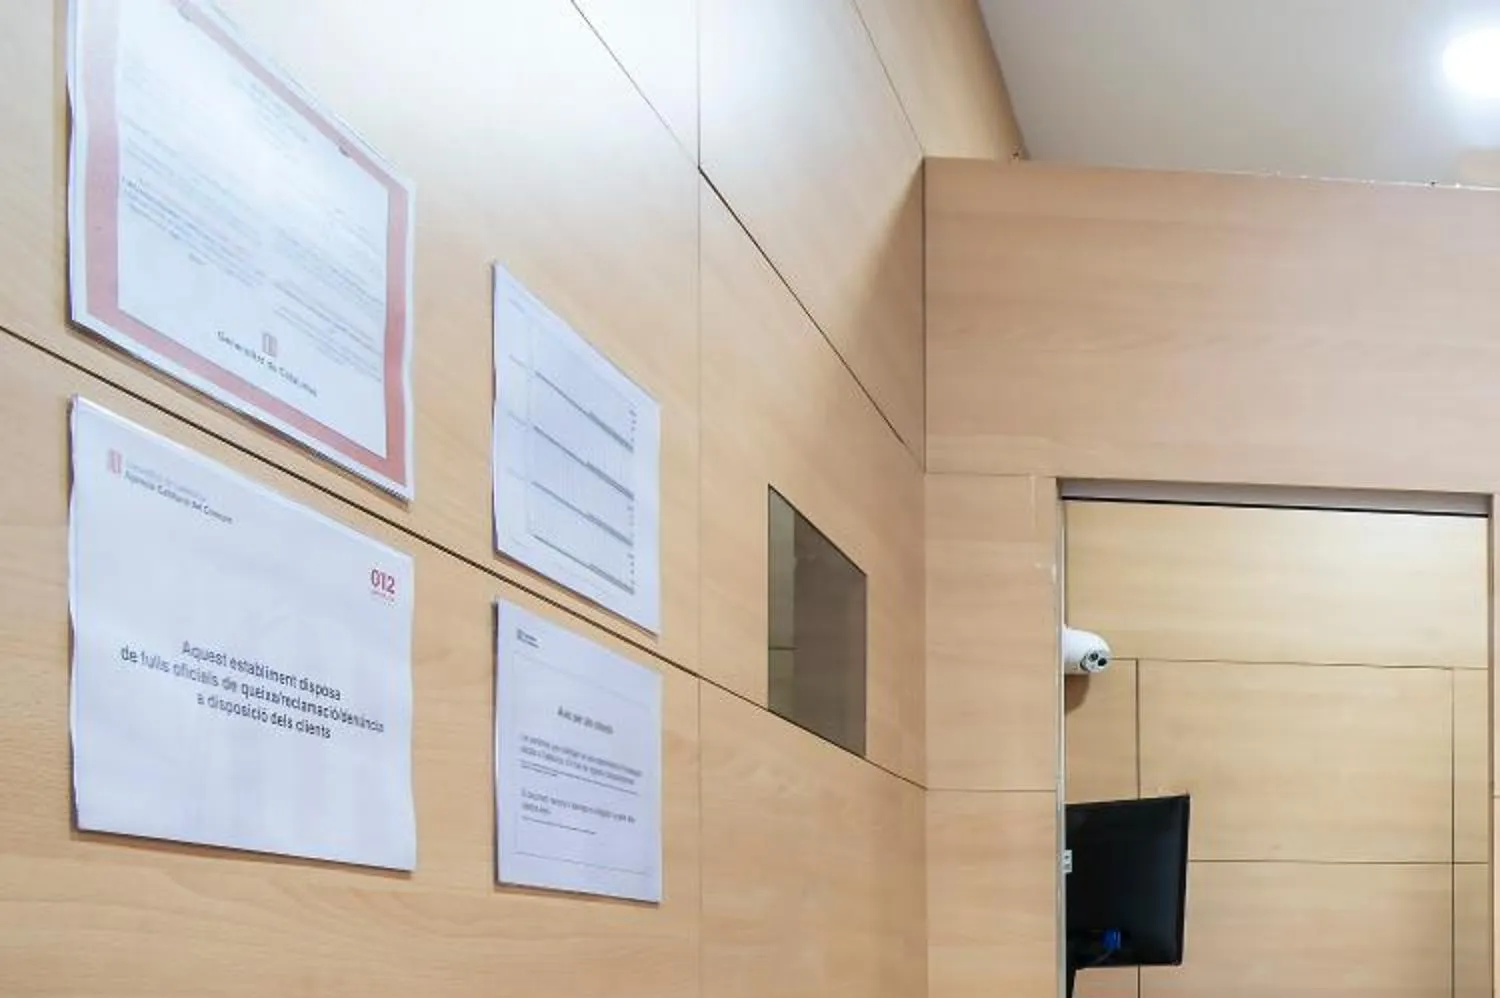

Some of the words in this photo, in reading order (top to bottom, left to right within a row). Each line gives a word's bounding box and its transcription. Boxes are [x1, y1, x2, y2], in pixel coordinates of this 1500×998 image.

[371, 569, 395, 594] 012
[121, 645, 138, 663] de
[173, 663, 219, 687] oficials
[221, 676, 237, 692] de
[182, 640, 227, 667] Aquest
[230, 658, 297, 688] establiment
[299, 678, 341, 699] disposa
[197, 693, 205, 705] a
[207, 695, 268, 723] disposició
[270, 711, 293, 729] dels
[295, 719, 331, 739] clients
